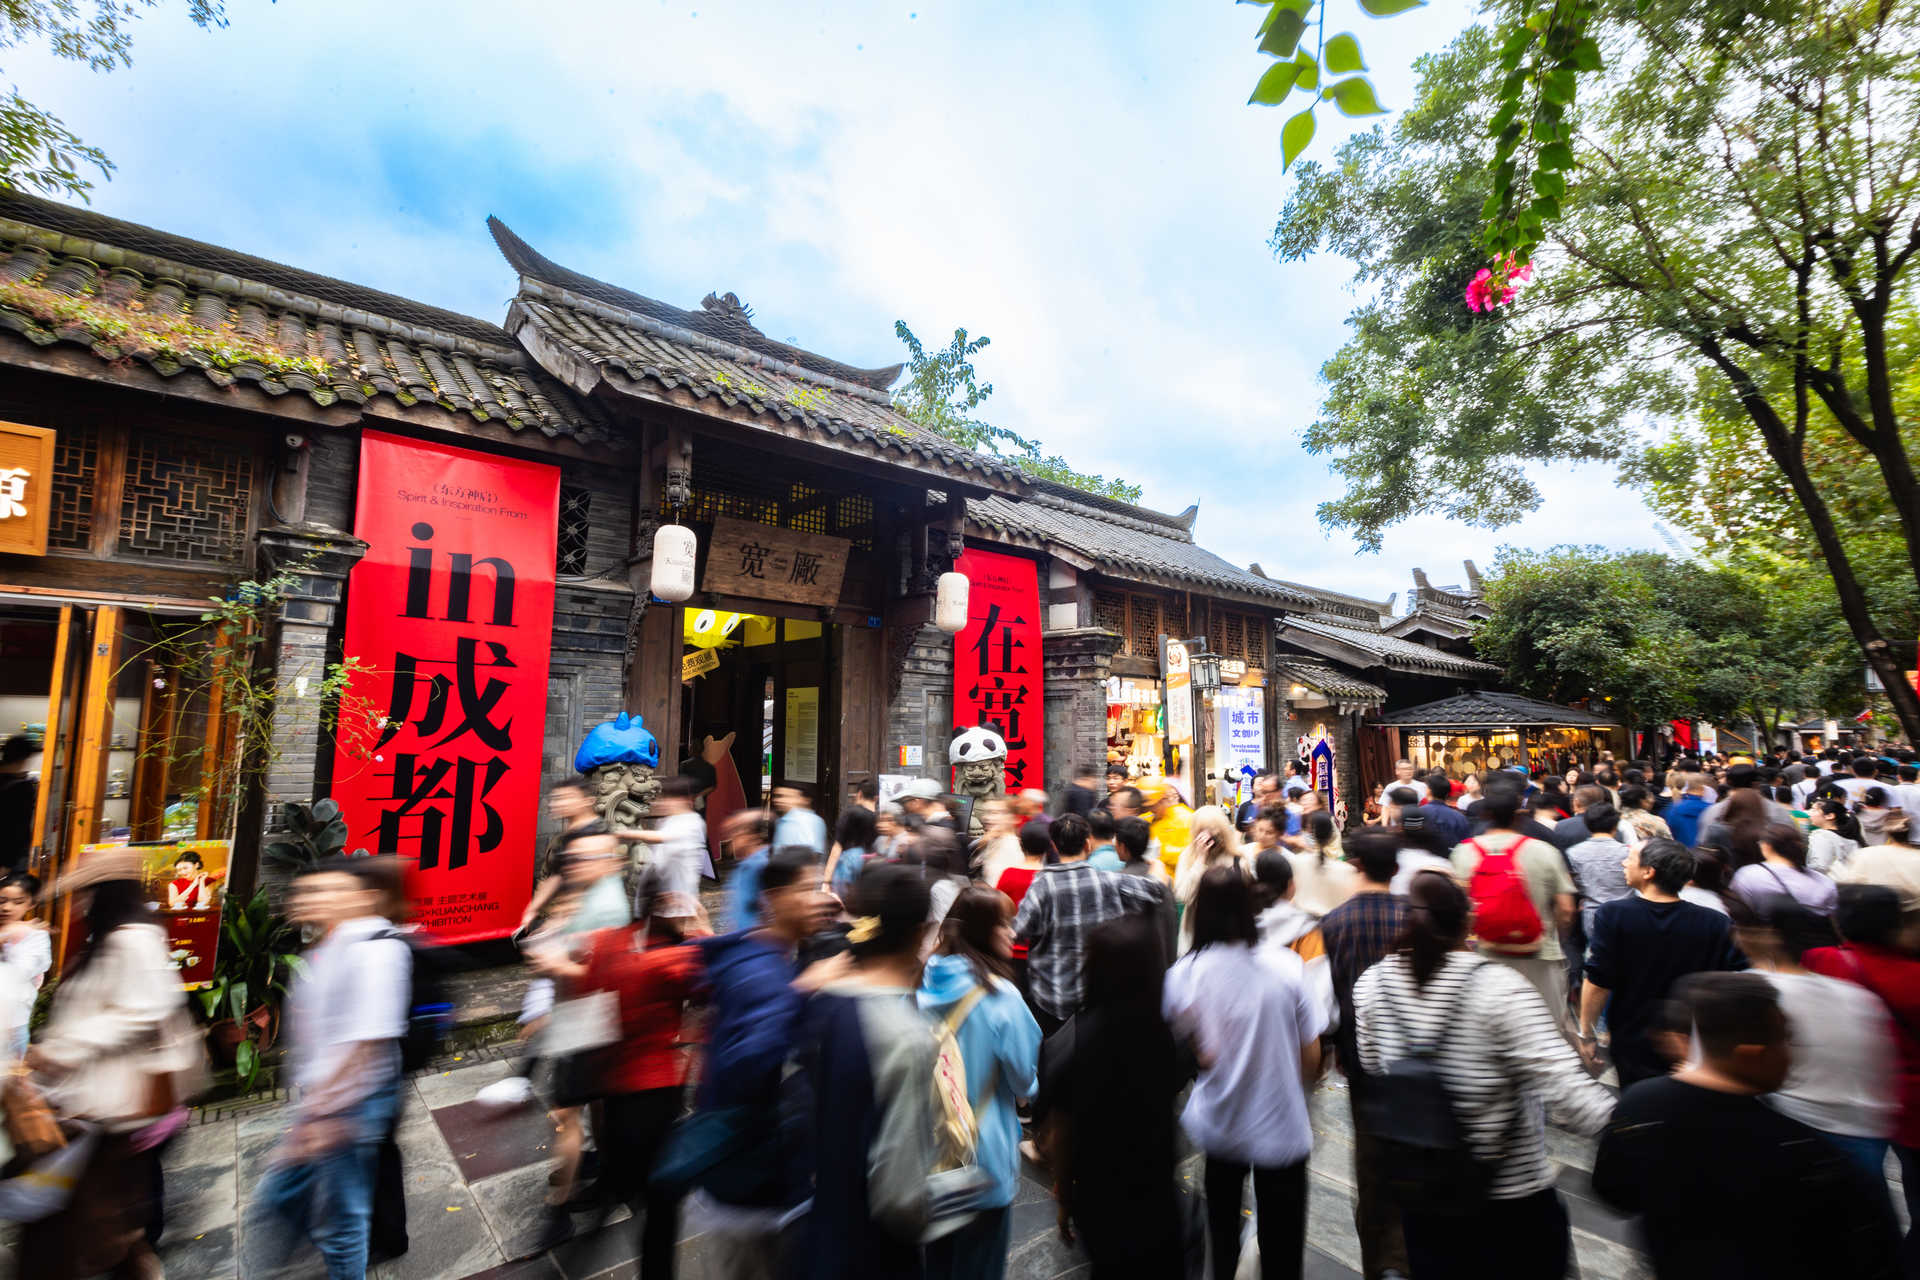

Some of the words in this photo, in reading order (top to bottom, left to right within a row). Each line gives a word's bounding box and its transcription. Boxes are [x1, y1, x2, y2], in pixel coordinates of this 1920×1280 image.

[398, 489, 427, 504] Spirit
[430, 496, 439, 505] &
[442, 498, 497, 516] Inspiration
[500, 507, 528, 520] From
[397, 522, 518, 627] in
[1231, 711, 1260, 724] 城市
[363, 636, 518, 871] 成都
